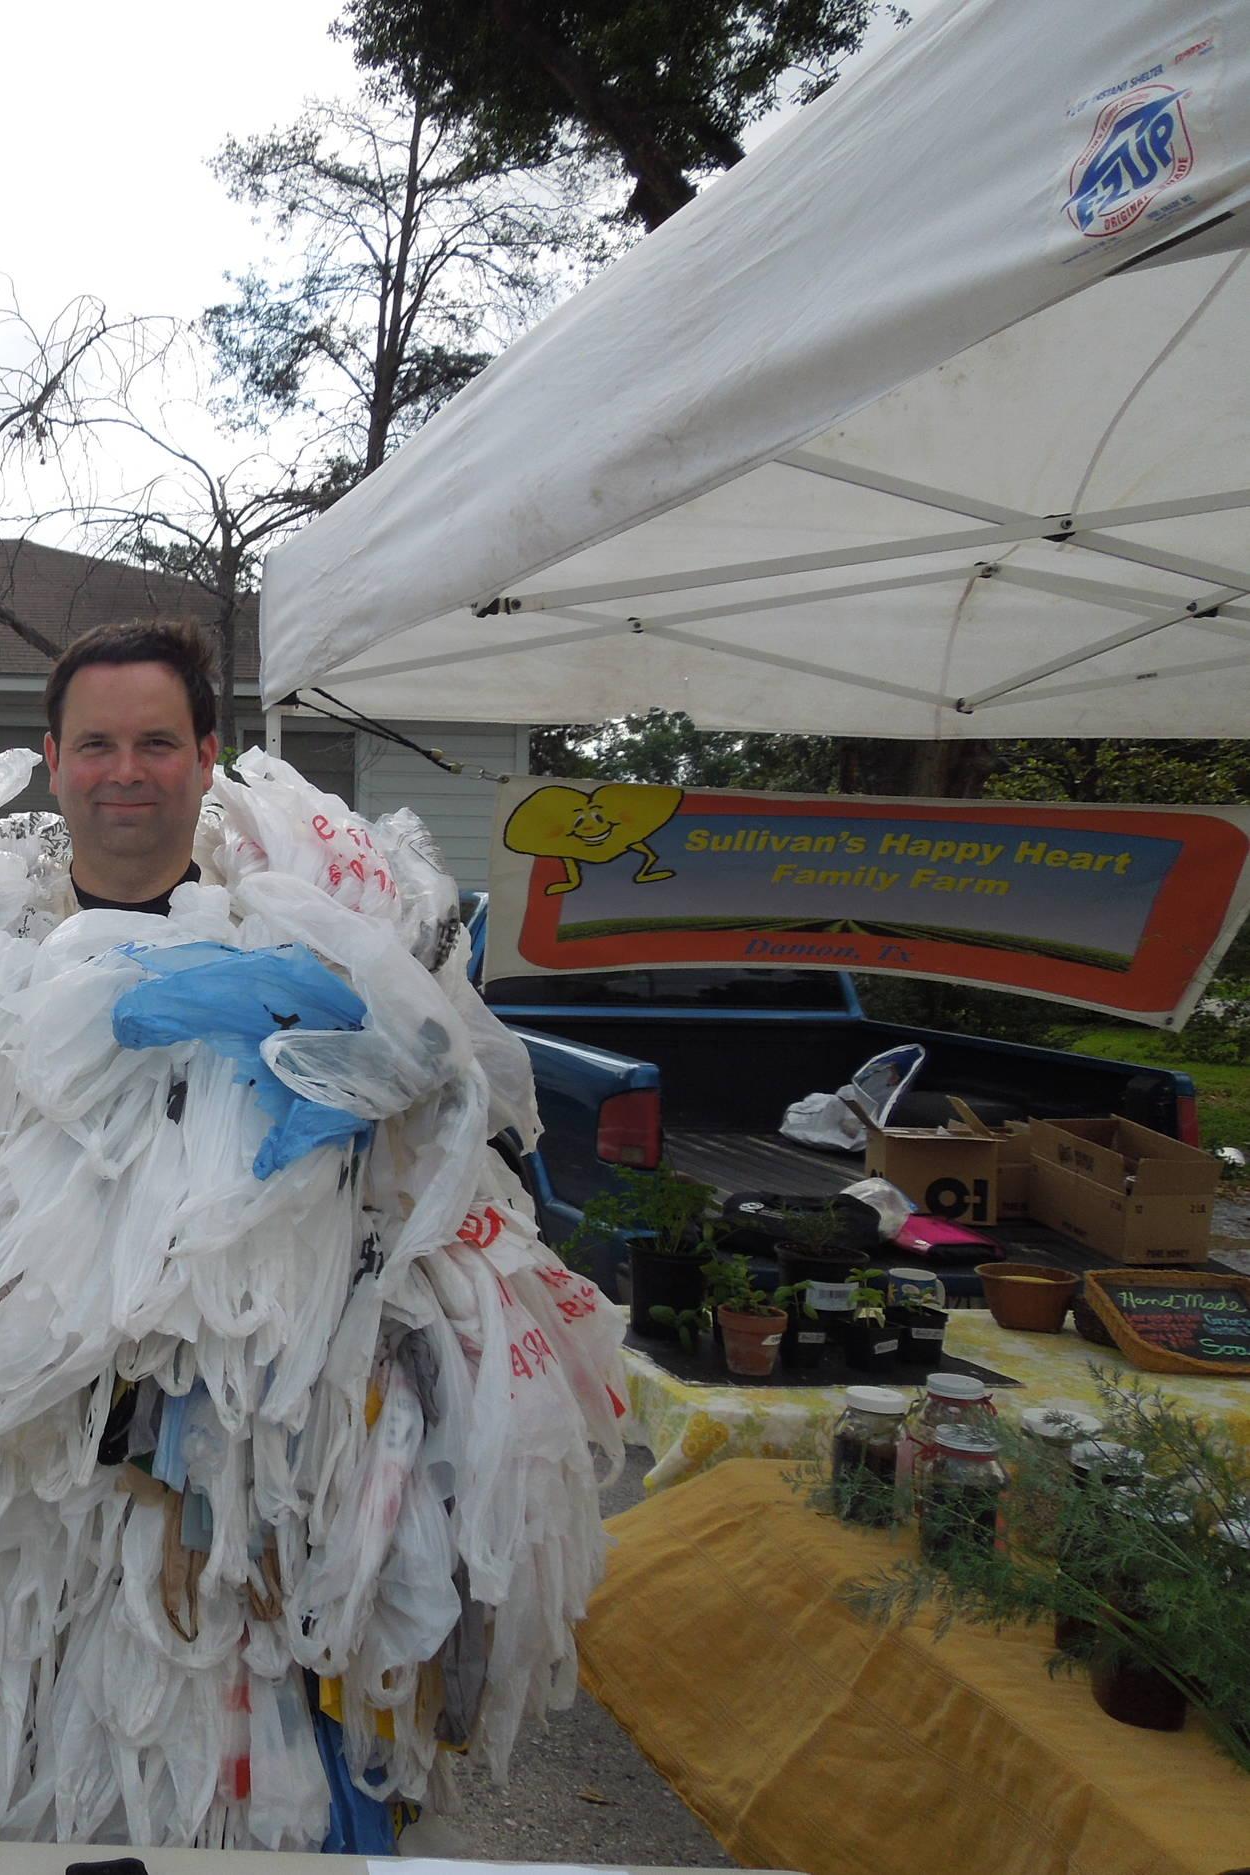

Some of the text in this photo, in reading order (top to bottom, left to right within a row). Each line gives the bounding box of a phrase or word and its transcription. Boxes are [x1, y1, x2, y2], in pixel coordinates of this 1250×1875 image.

[685, 828, 1132, 875] Sullivan's Happy Heart
[771, 864, 1010, 896] Family Farm
[745, 938, 916, 963] Damon, Tx
[1118, 1291, 1248, 1313] Hand Made
